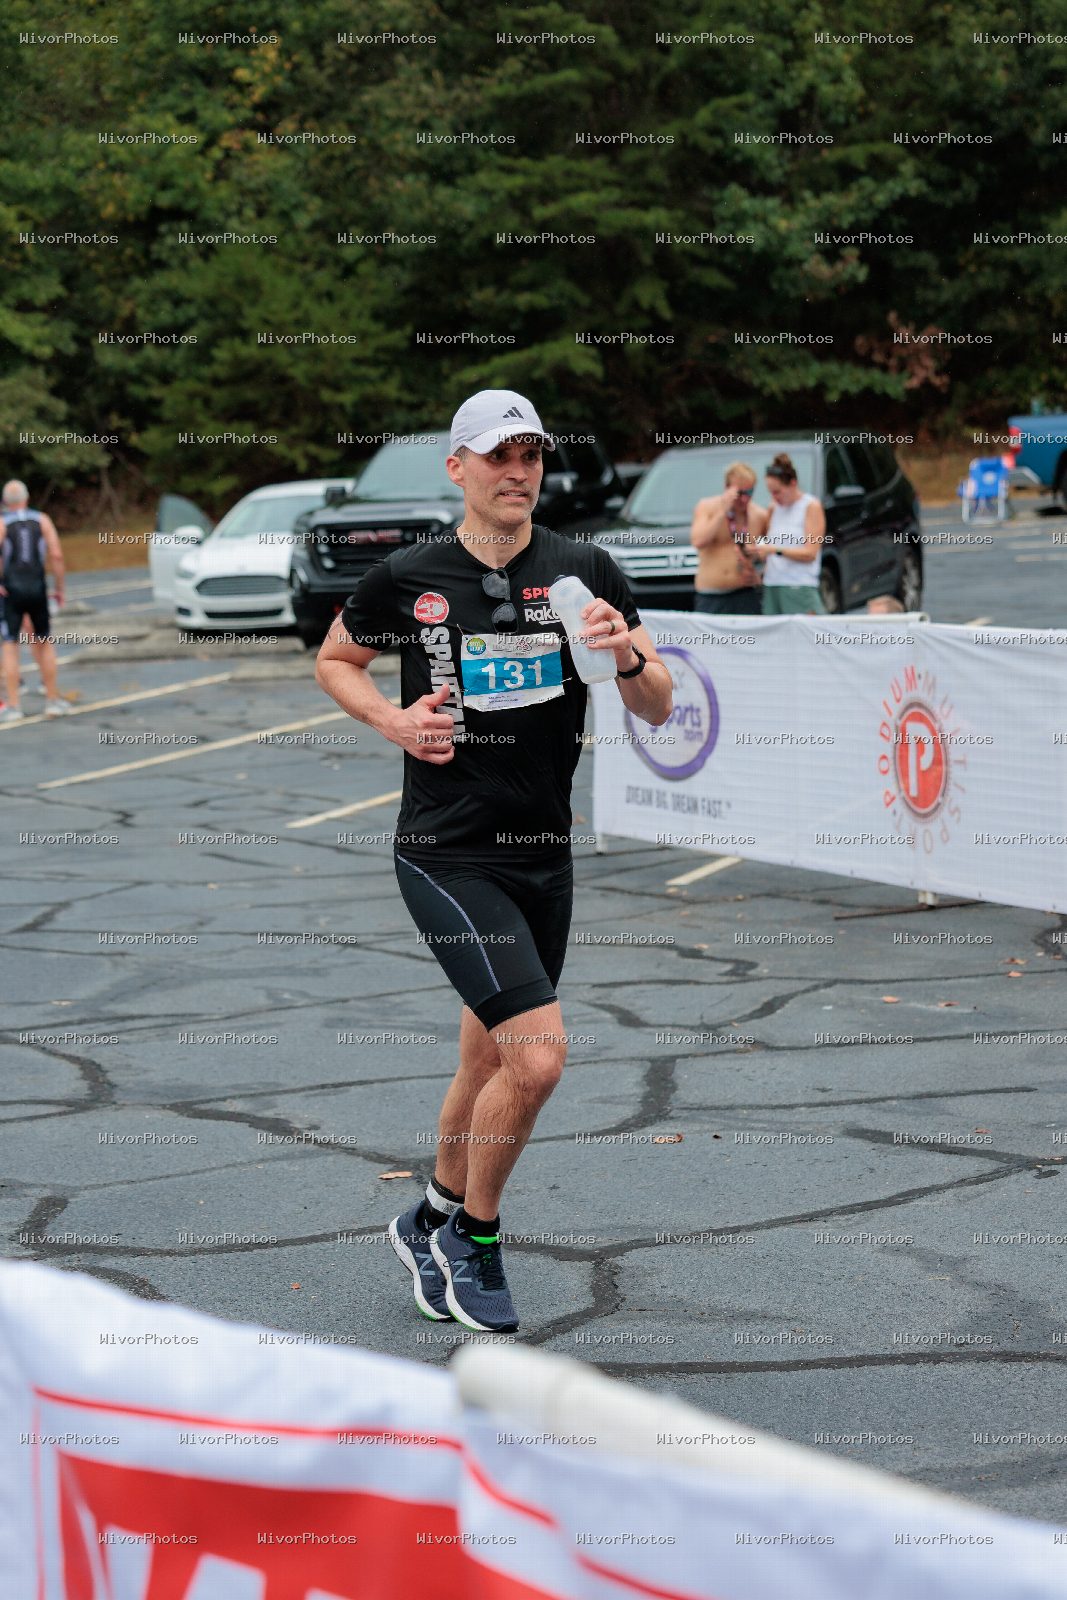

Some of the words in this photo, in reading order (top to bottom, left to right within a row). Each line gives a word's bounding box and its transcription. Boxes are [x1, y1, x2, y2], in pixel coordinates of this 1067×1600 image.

[481, 659, 543, 690] 131
[877, 665, 918, 809] PODIUM
[905, 720, 935, 798] P
